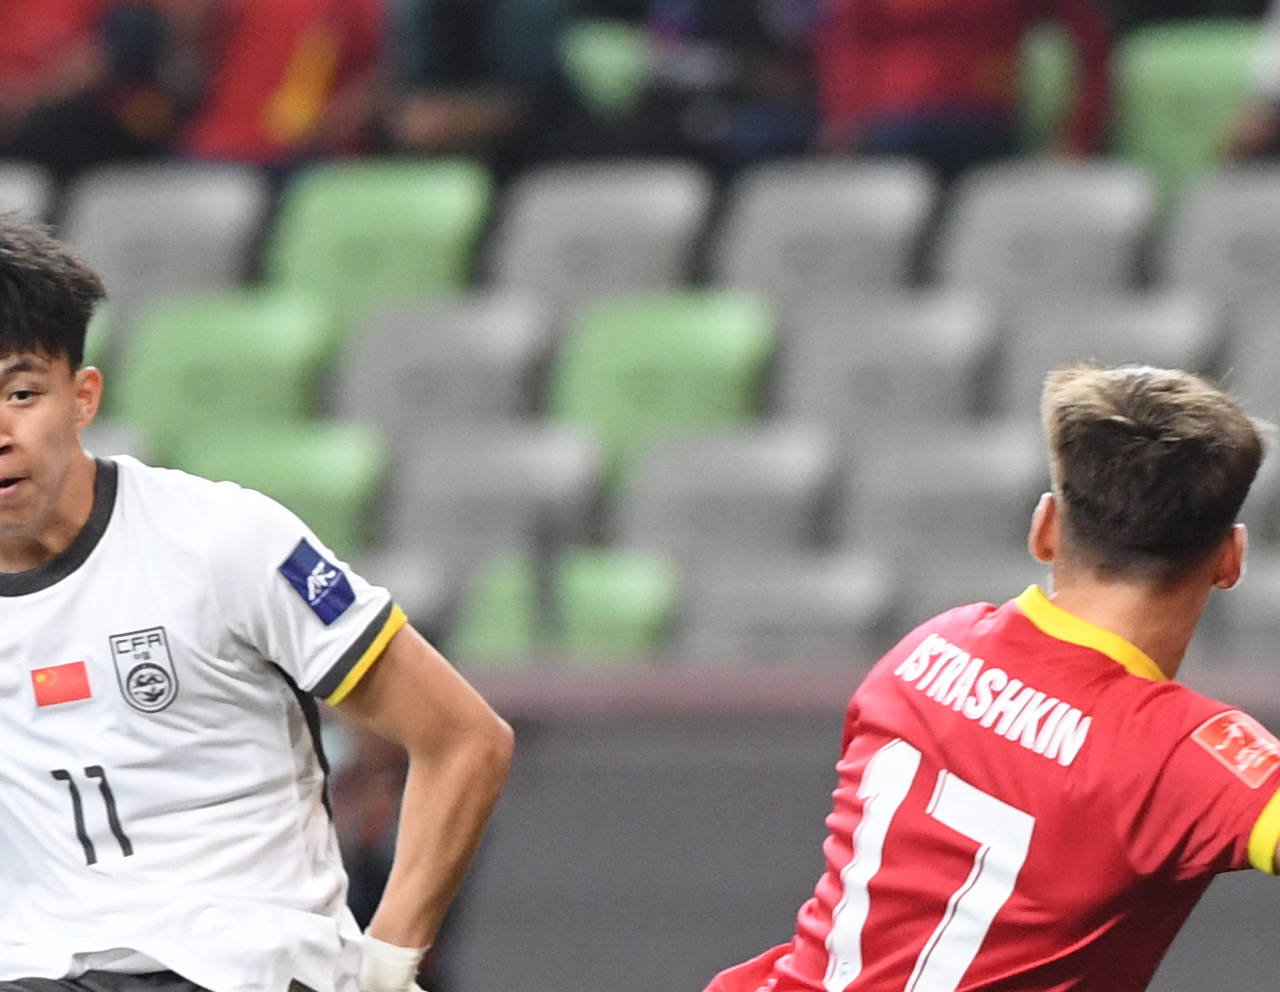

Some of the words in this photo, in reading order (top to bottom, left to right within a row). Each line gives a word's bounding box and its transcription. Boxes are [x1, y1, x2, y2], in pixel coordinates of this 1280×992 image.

[115, 633, 163, 654] CFA
[894, 633, 1093, 767] ISTRASHKIN
[51, 765, 132, 865] 11
